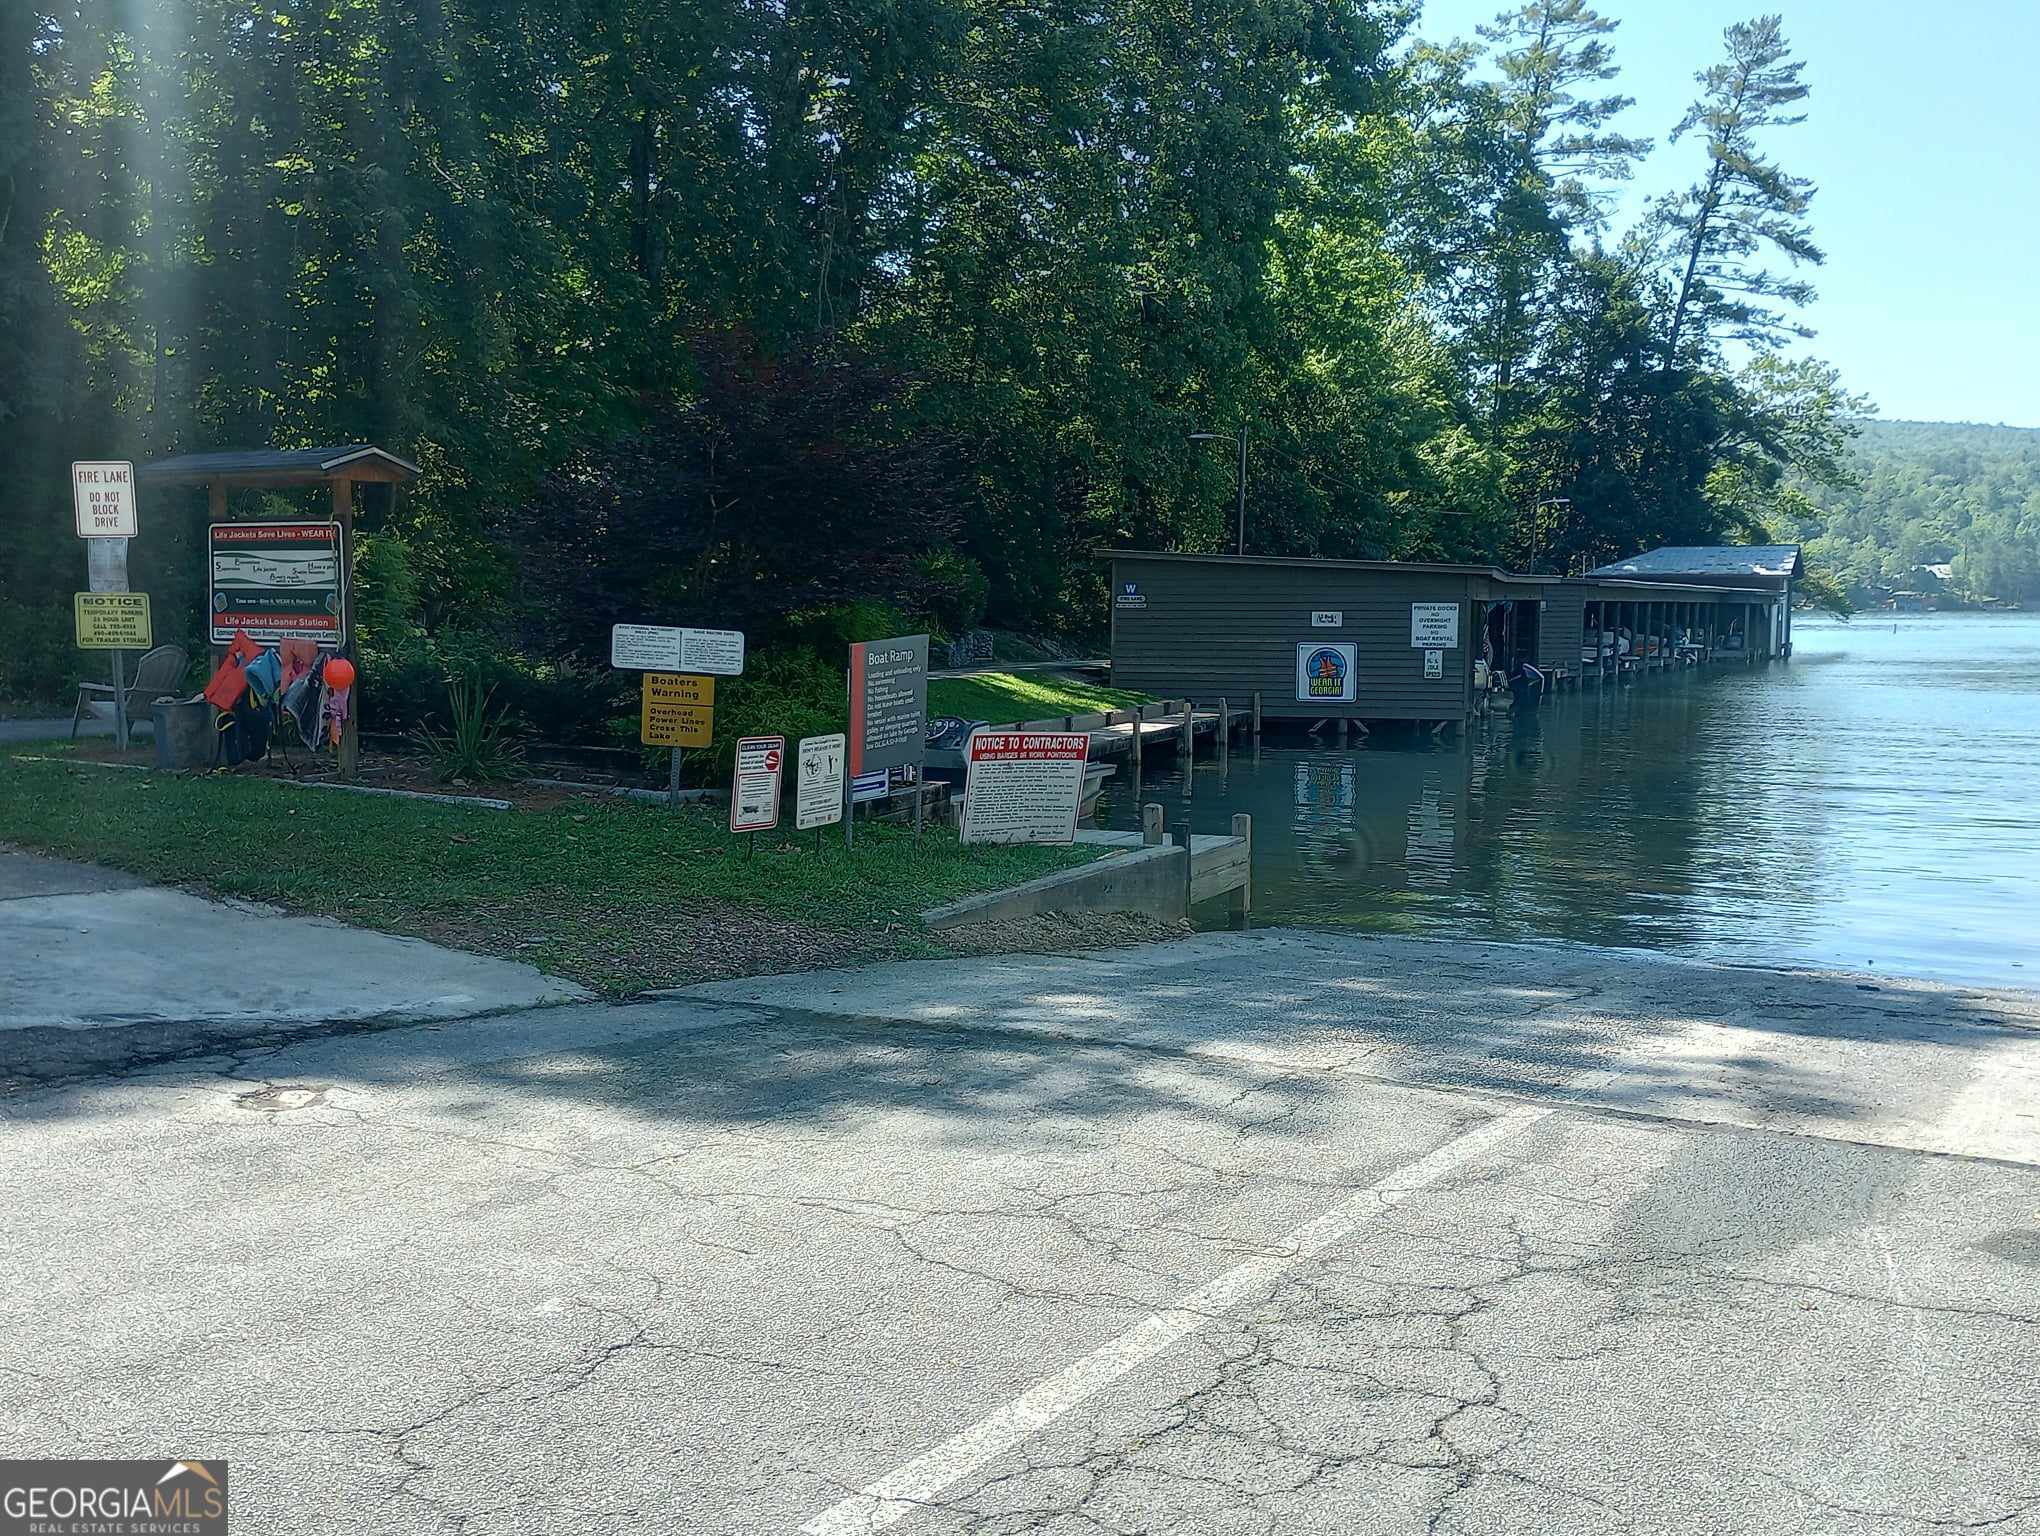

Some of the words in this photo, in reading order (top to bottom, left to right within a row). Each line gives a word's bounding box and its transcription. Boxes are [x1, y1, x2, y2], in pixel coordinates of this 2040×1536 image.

[78, 471, 100, 483] FIRE
[104, 471, 128, 483] LANE
[90, 492, 100, 502] DO
[104, 492, 120, 502] NOT
[92, 504, 119, 515] BLOCK
[94, 516, 119, 528] DRIVE
[229, 530, 257, 538] Jackets
[258, 530, 276, 538] Save
[277, 530, 296, 538] Lives
[301, 530, 324, 538] WEAR
[1126, 584, 1136, 593] W
[83, 598, 143, 606] NOTICE
[224, 616, 240, 625] Life
[241, 616, 267, 625] Jacket
[269, 617, 297, 626] Loaner
[299, 617, 329, 627] Station
[868, 652, 888, 665] Boat
[890, 649, 913, 663] Ramp
[651, 676, 698, 686] Boaters
[1310, 678, 1333, 686] WEAR
[1334, 678, 1342, 686] IT
[651, 688, 699, 700] Warning
[1310, 686, 1342, 695] GEORGIA!
[650, 708, 694, 716] Overhead
[650, 716, 678, 724] Power
[682, 717, 705, 725] Lines
[975, 738, 1005, 750] NOTICE
[1008, 738, 1020, 749] TO
[1023, 737, 1084, 750] CONTRACTORS
[979, 752, 996, 760] USING
